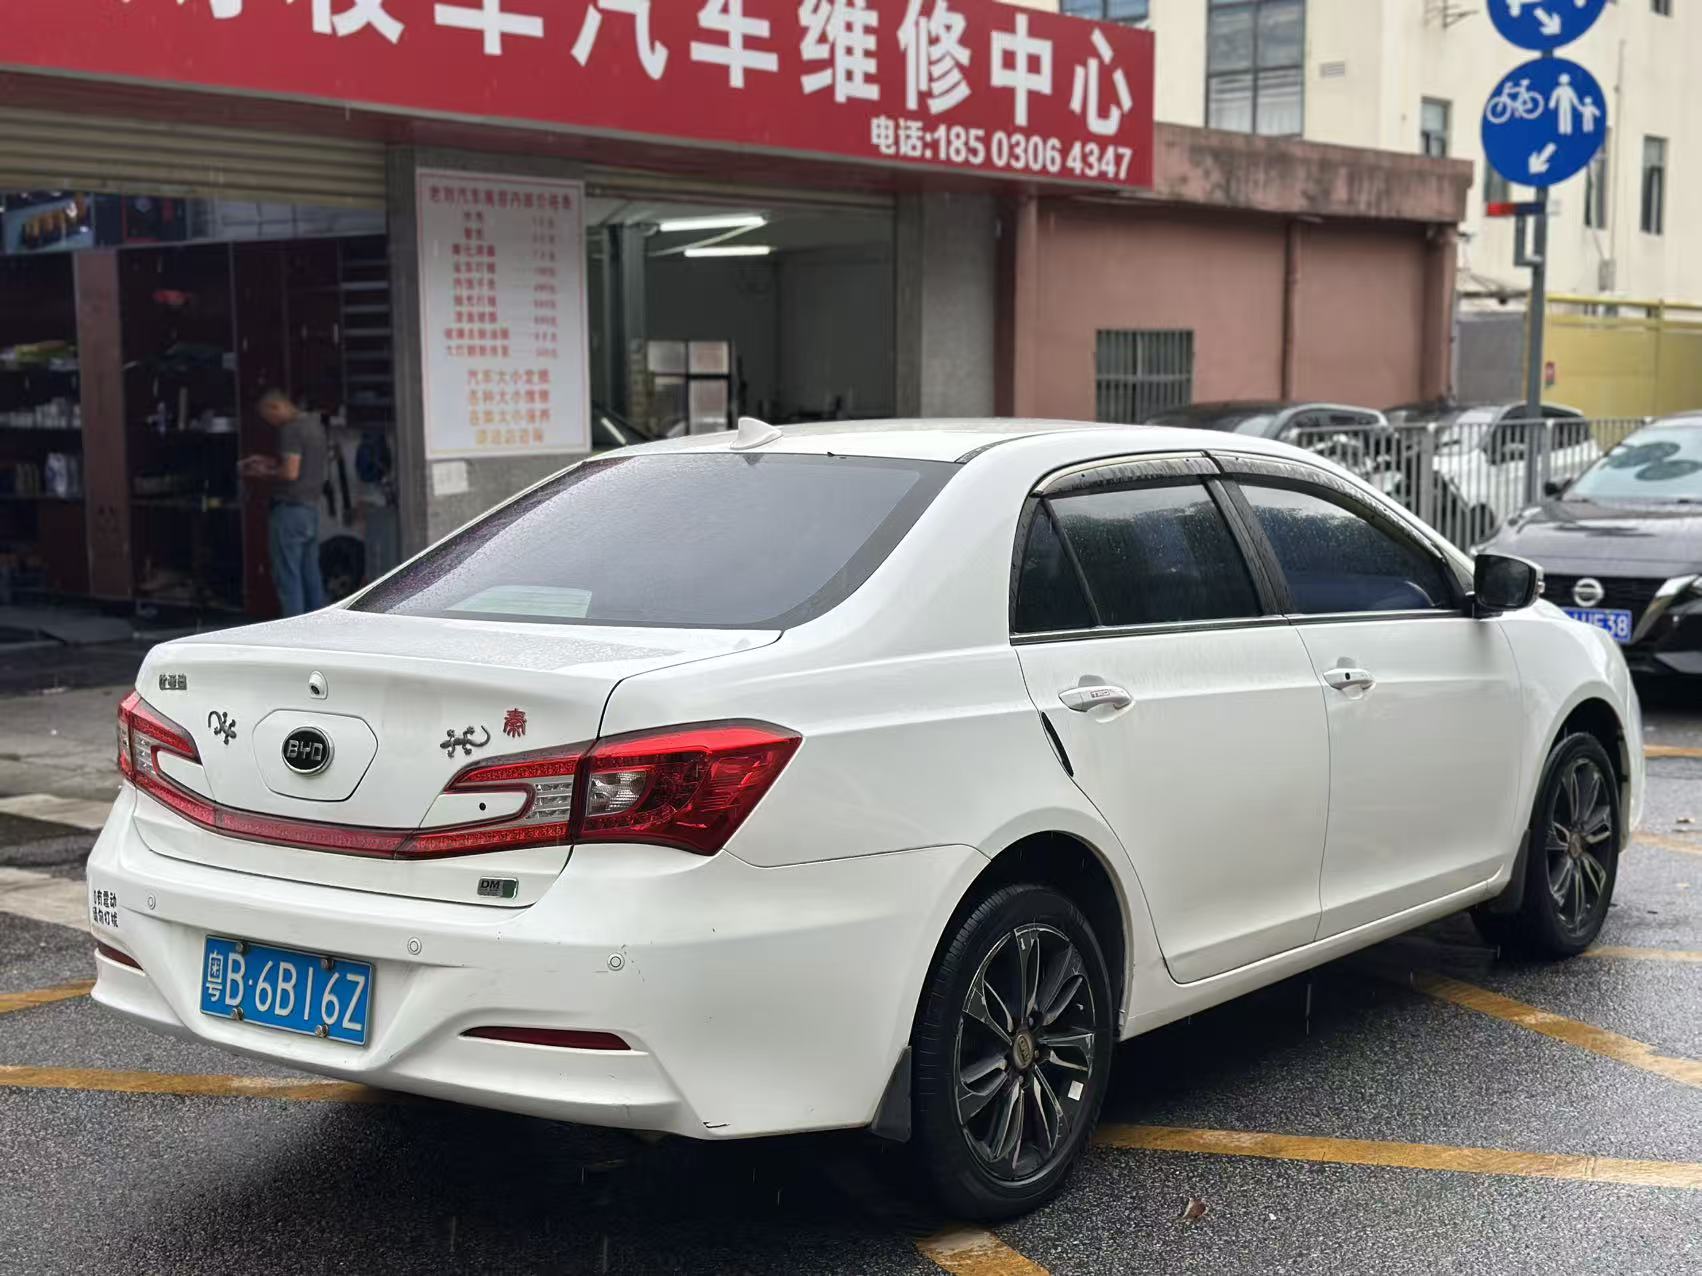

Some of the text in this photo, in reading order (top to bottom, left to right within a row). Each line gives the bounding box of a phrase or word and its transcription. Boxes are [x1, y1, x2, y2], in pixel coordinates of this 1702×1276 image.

[991, 130, 1062, 174] 0306
[1066, 141, 1133, 181] 4347
[286, 739, 323, 762] BYD
